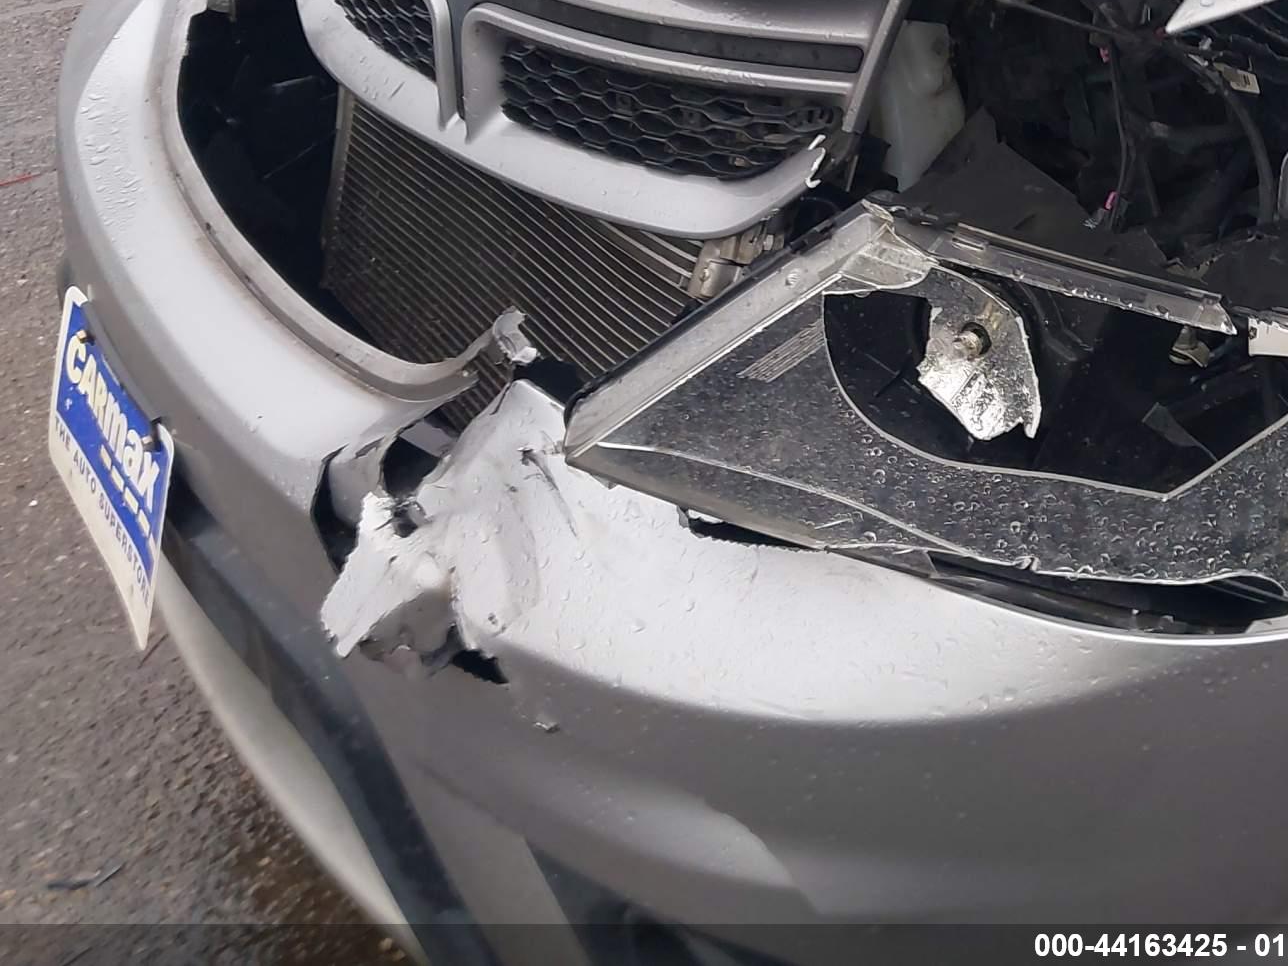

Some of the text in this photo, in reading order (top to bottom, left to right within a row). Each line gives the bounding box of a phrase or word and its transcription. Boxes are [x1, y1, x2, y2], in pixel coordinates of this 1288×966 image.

[55, 415, 150, 608] THE AUTO SUPERSTORE
